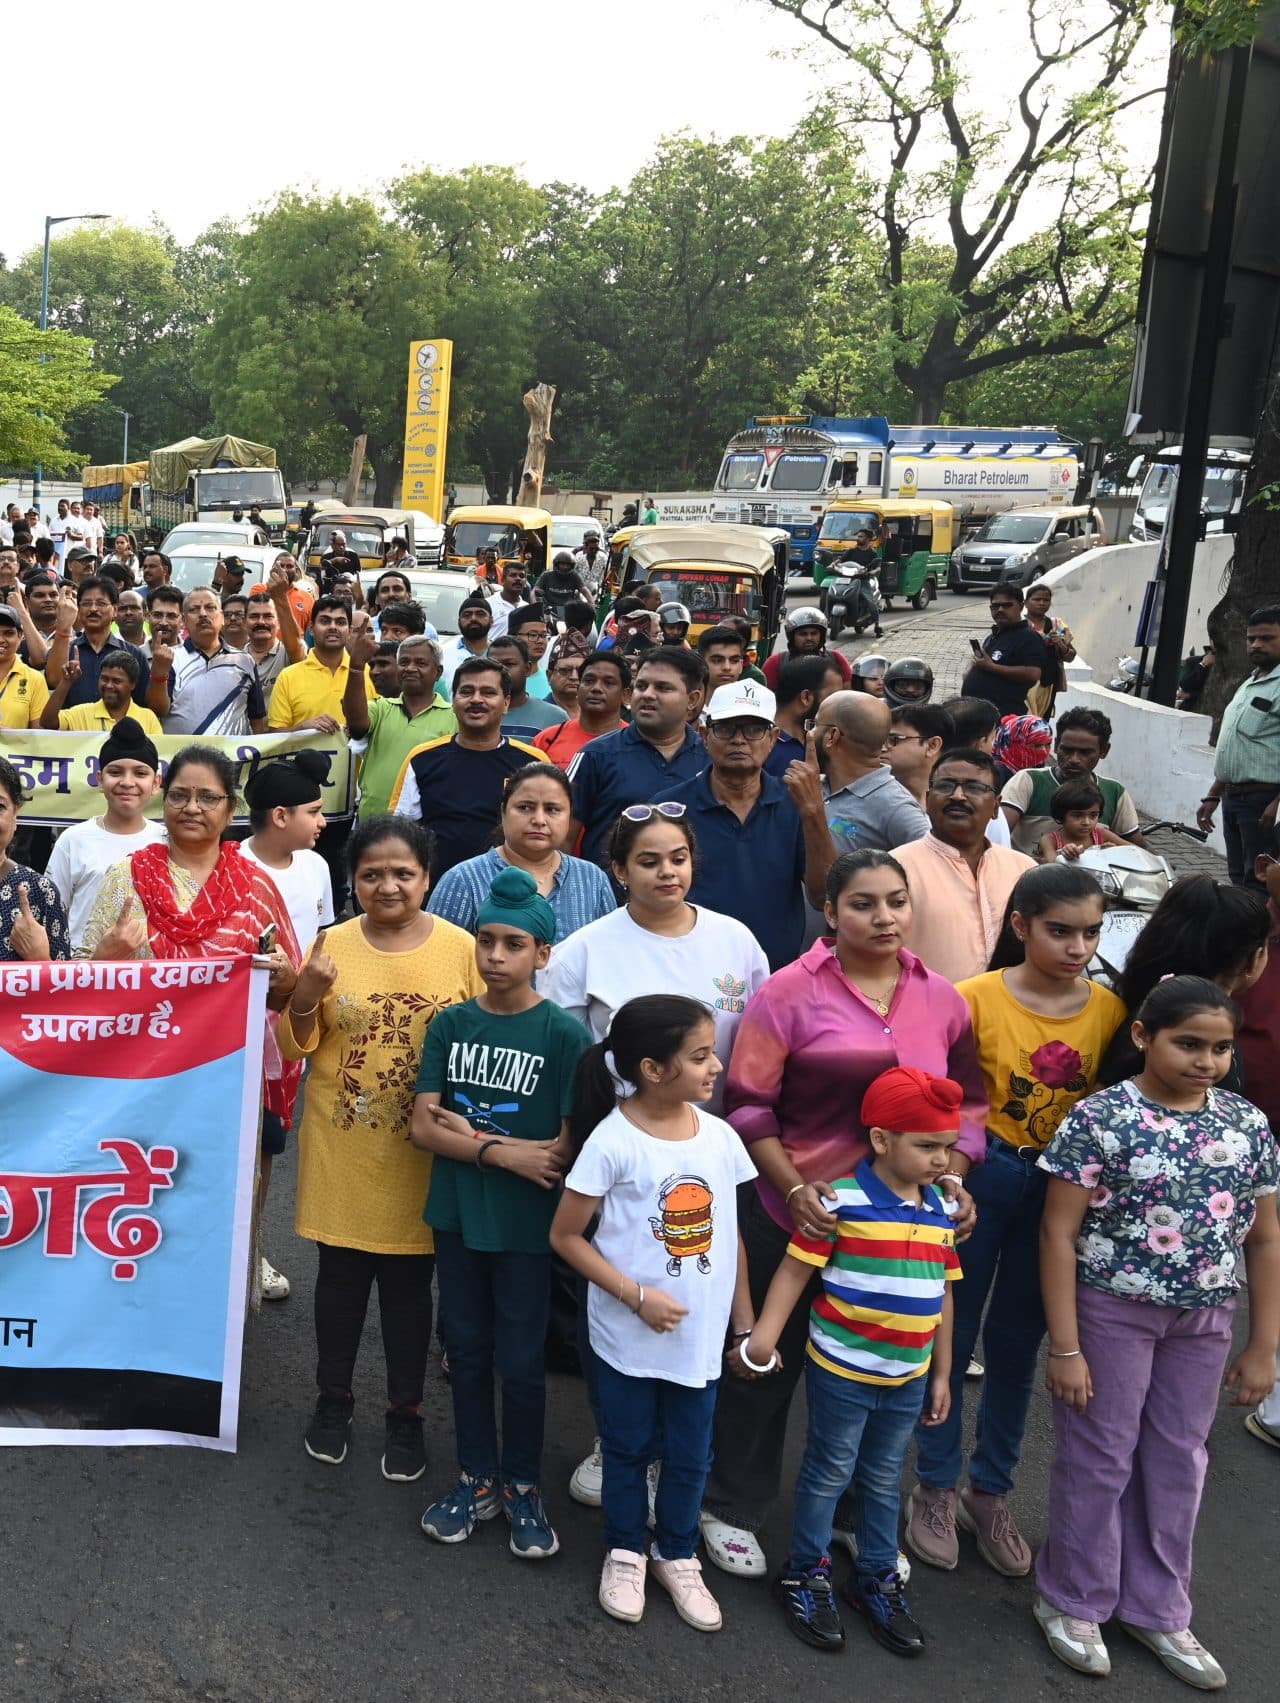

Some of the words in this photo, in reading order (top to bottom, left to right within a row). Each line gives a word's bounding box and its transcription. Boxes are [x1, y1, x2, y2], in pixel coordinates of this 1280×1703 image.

[944, 469, 977, 485] Bharat
[980, 469, 1029, 485] Petroleum
[48, 961, 143, 994] प्रभात
[149, 960, 235, 989] खबर
[21, 1011, 144, 1043] उपलब्ध
[447, 1042, 545, 1096] AMAZING
